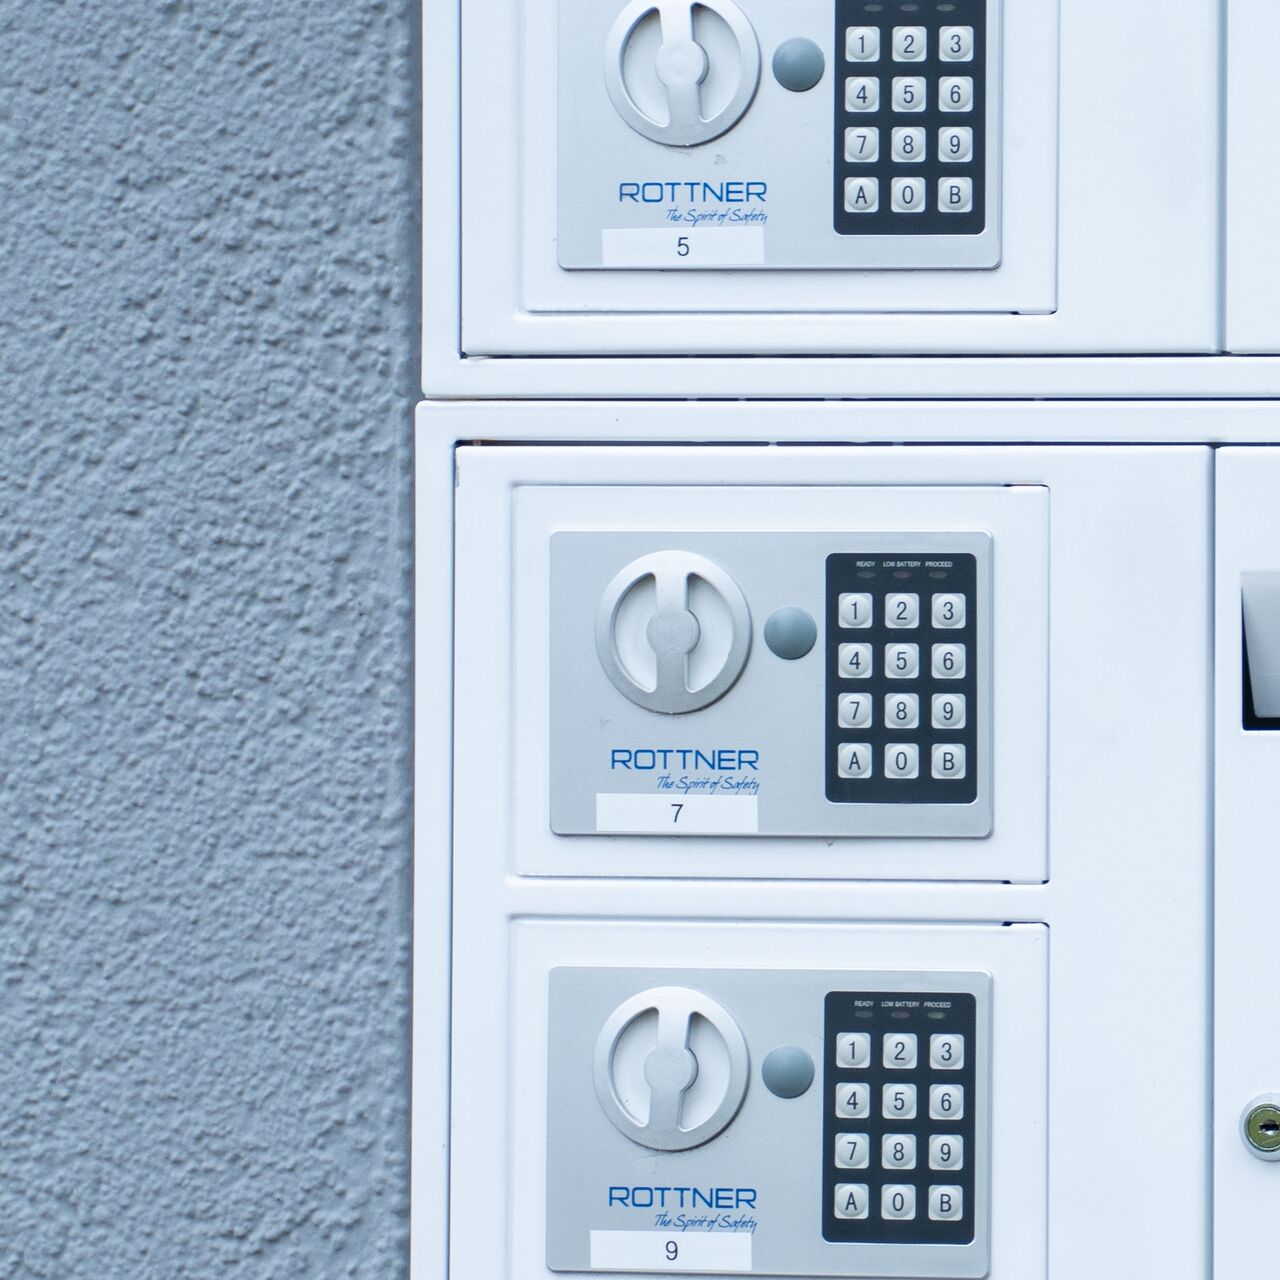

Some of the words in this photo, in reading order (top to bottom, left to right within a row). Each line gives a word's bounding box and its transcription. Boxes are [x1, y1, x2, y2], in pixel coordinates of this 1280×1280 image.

[620, 182, 767, 202] ROTTNER
[666, 206, 682, 221] The
[684, 209, 717, 227] Spirit
[717, 208, 730, 225] of
[729, 208, 767, 224] Safety
[677, 237, 689, 256] 5
[612, 750, 758, 770] ROTTNER
[657, 773, 674, 789] The
[676, 776, 710, 794] Spirit
[710, 776, 722, 794] of
[721, 776, 759, 795] Safety
[671, 804, 684, 823] 7
[894, 1041, 907, 1062] 2
[941, 1042, 954, 1063] 3
[846, 1091, 860, 1112] 4
[893, 1092, 906, 1112] 5
[940, 1092, 953, 1113] 6
[847, 1141, 858, 1162] 7
[893, 1142, 906, 1163] 8
[940, 1143, 952, 1164] 9
[609, 1187, 756, 1208] ROTTNER
[845, 1191, 859, 1212] A
[892, 1192, 906, 1213] 0
[939, 1193, 953, 1214] B
[655, 1211, 671, 1227] The
[674, 1214, 708, 1232] Spirit
[708, 1214, 720, 1232] of
[718, 1214, 757, 1234] Safety
[666, 1241, 678, 1260] 9
